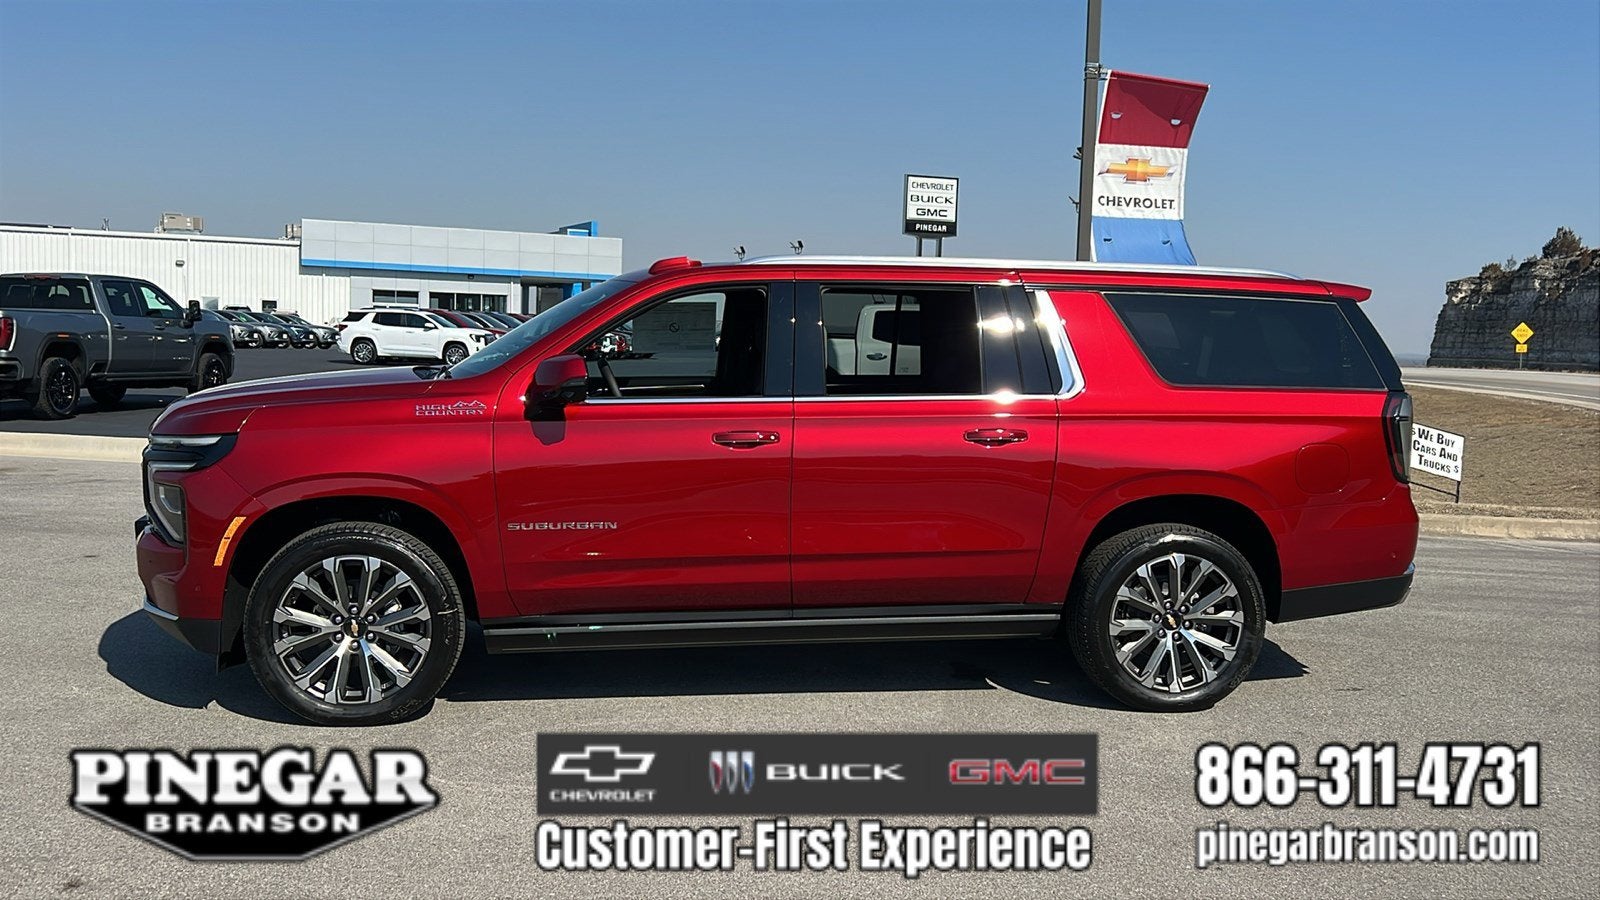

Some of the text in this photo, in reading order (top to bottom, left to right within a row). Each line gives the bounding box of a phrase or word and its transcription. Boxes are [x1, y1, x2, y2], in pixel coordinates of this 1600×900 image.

[911, 181, 955, 191] CHEVROLET
[910, 194, 954, 205] BUICK
[1097, 195, 1175, 210] CHEVROLET
[916, 208, 948, 217] GMC
[915, 223, 947, 232] PINEGAR
[507, 521, 618, 531] SUBURBAN
